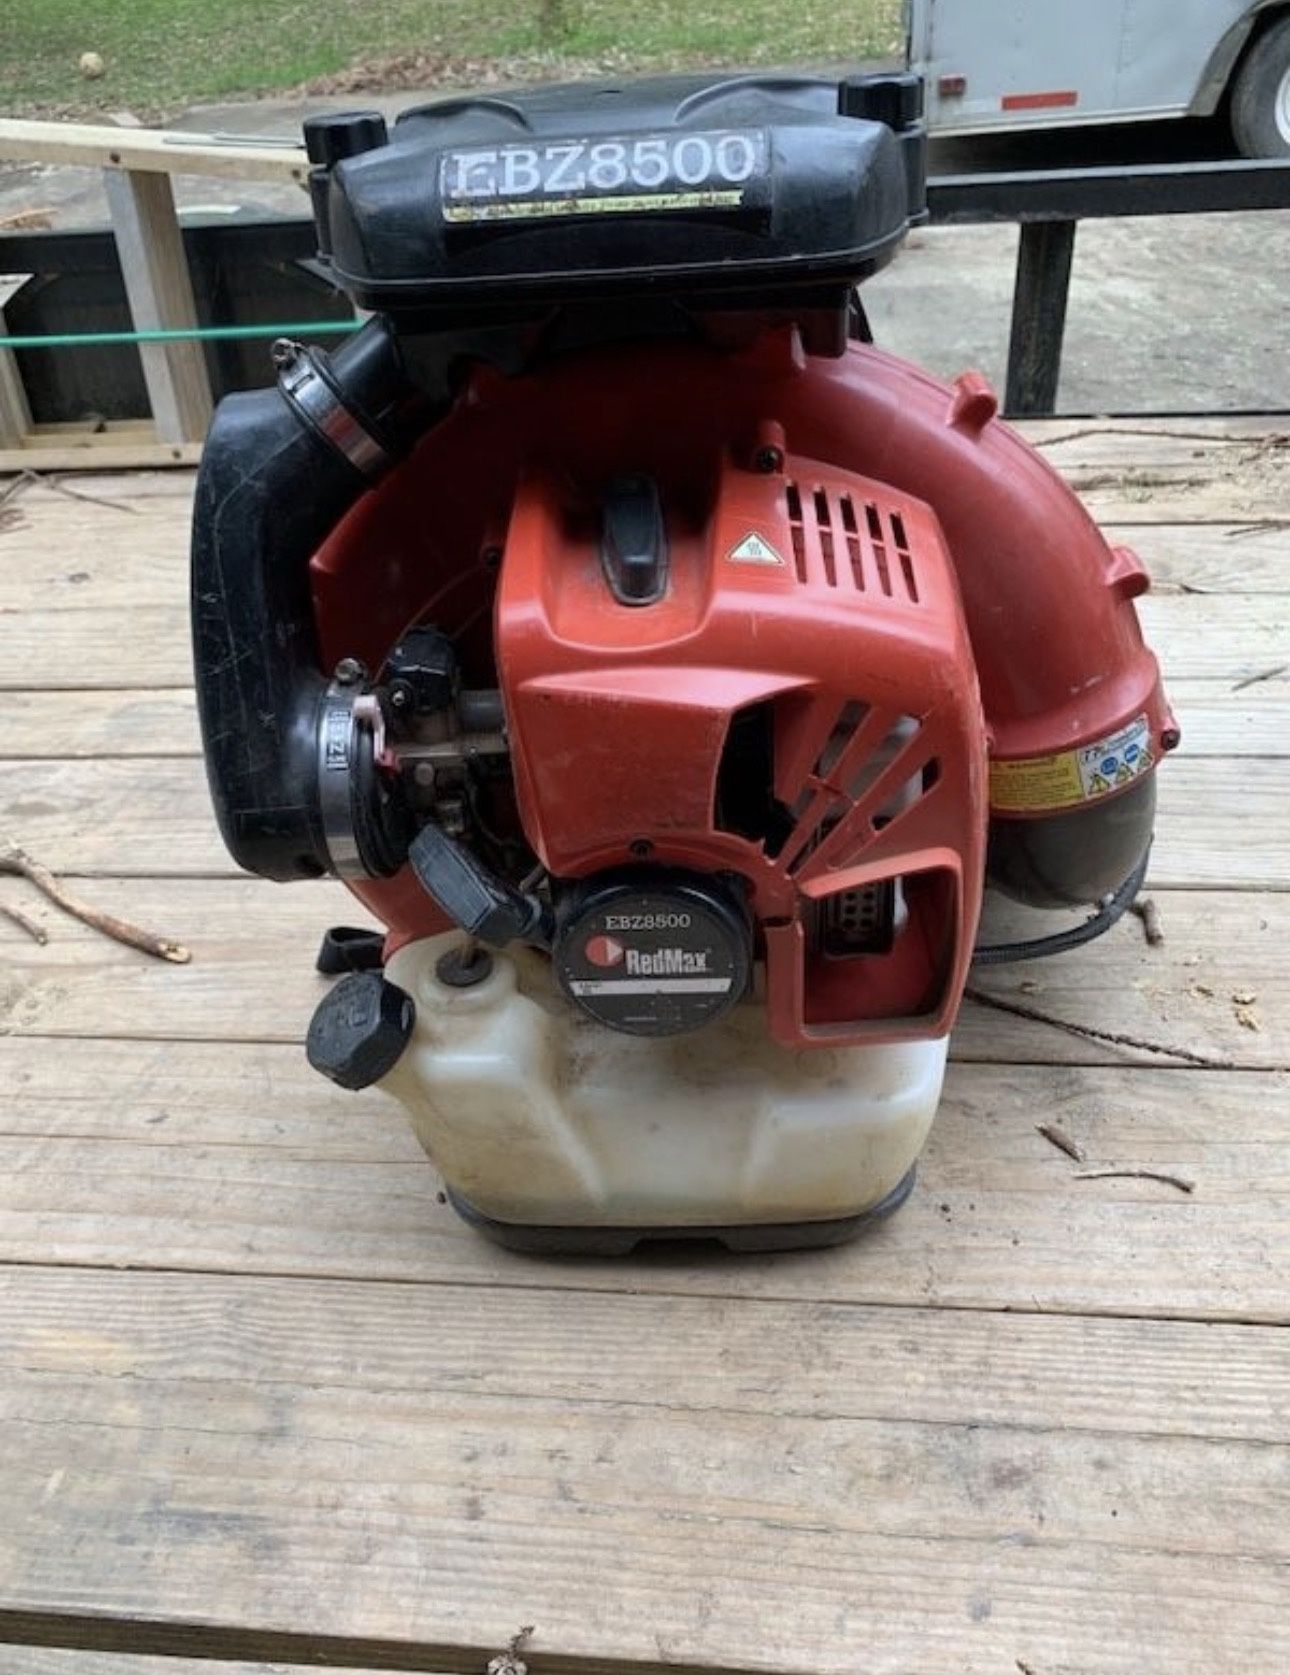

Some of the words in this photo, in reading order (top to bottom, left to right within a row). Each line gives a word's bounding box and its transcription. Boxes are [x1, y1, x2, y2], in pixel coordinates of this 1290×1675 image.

[451, 134, 756, 198] EBZ8500
[606, 914, 691, 930] EBZ8500
[627, 949, 706, 975] RedMax
